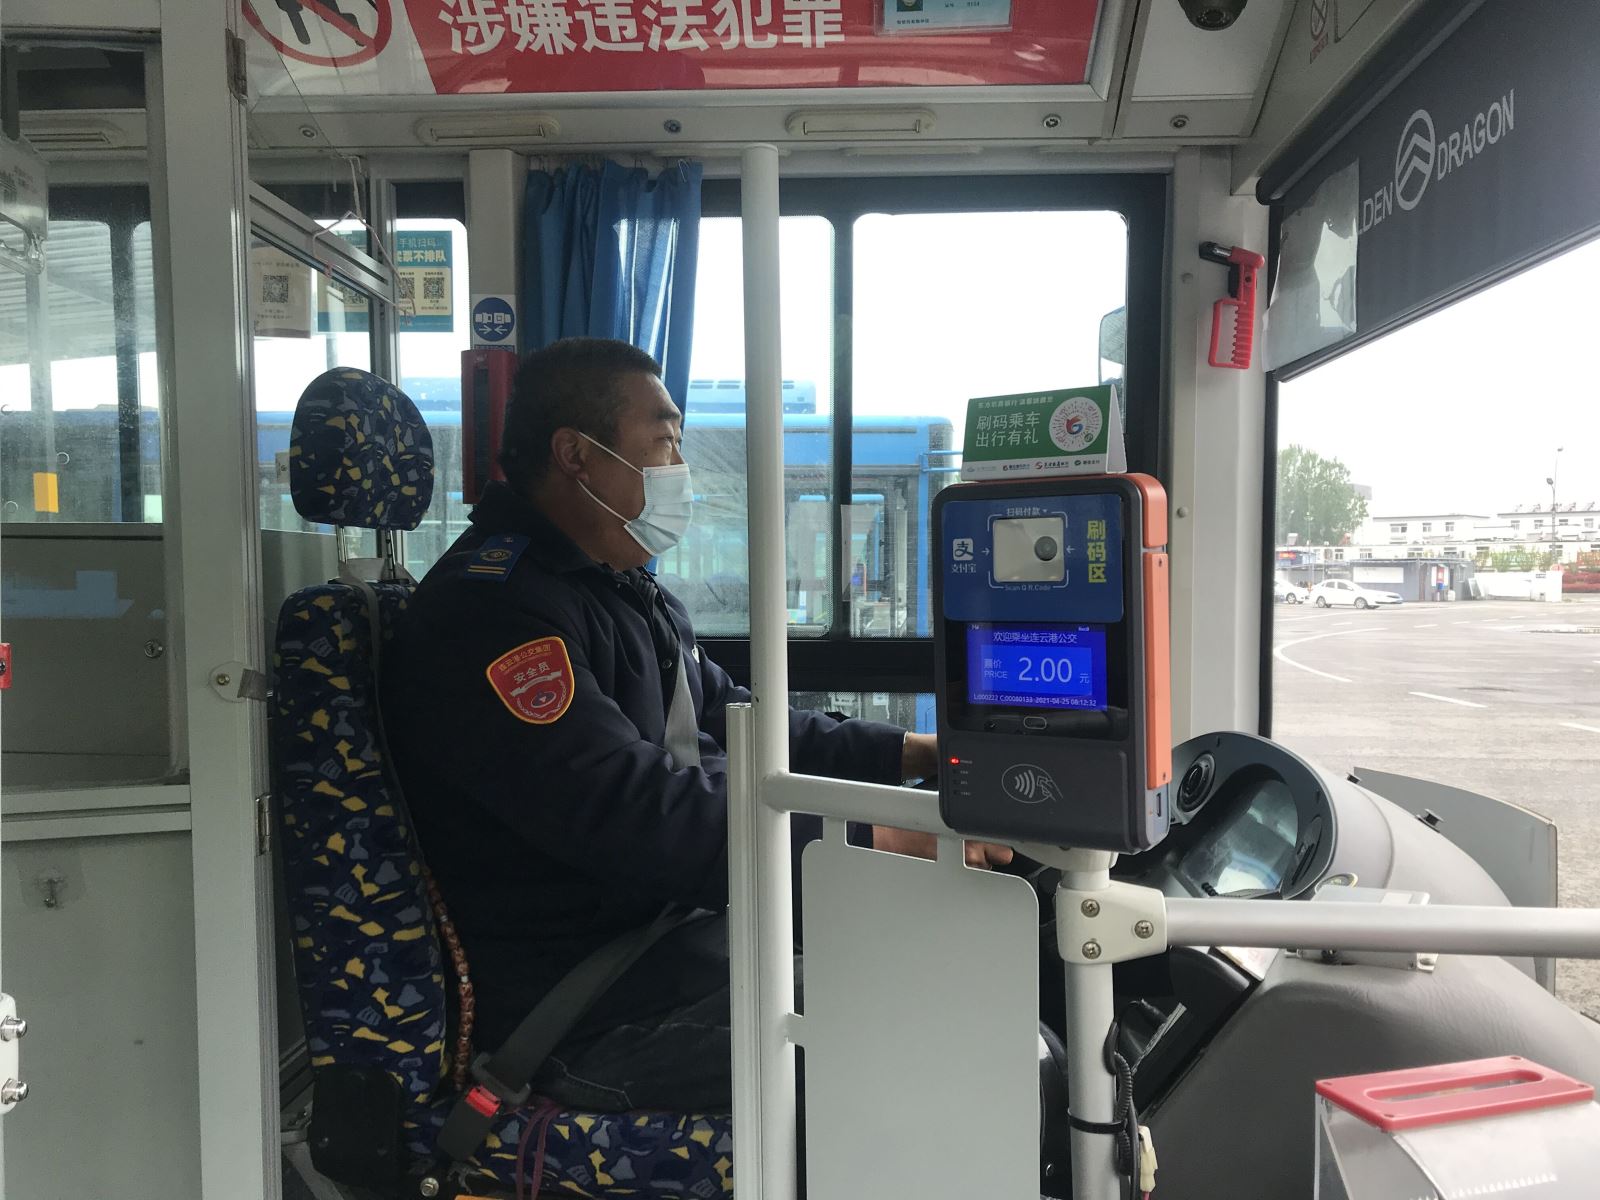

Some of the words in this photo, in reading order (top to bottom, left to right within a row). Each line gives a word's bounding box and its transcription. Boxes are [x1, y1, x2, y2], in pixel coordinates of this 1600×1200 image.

[440, 0, 845, 55] 涉嫌违法犯罪
[1357, 181, 1394, 235] DEN
[1436, 89, 1515, 181] DRAGON
[976, 411, 1041, 431] 刷码乘车
[975, 428, 1039, 448] 出行有礼
[1087, 520, 1106, 583] 刷码区
[951, 563, 977, 574] 支付宝
[993, 631, 1078, 644] 欢迎乘坐连云港公交
[984, 671, 1008, 679] PRICE
[1018, 656, 1073, 683] 2.00
[1079, 673, 1090, 684] 元
